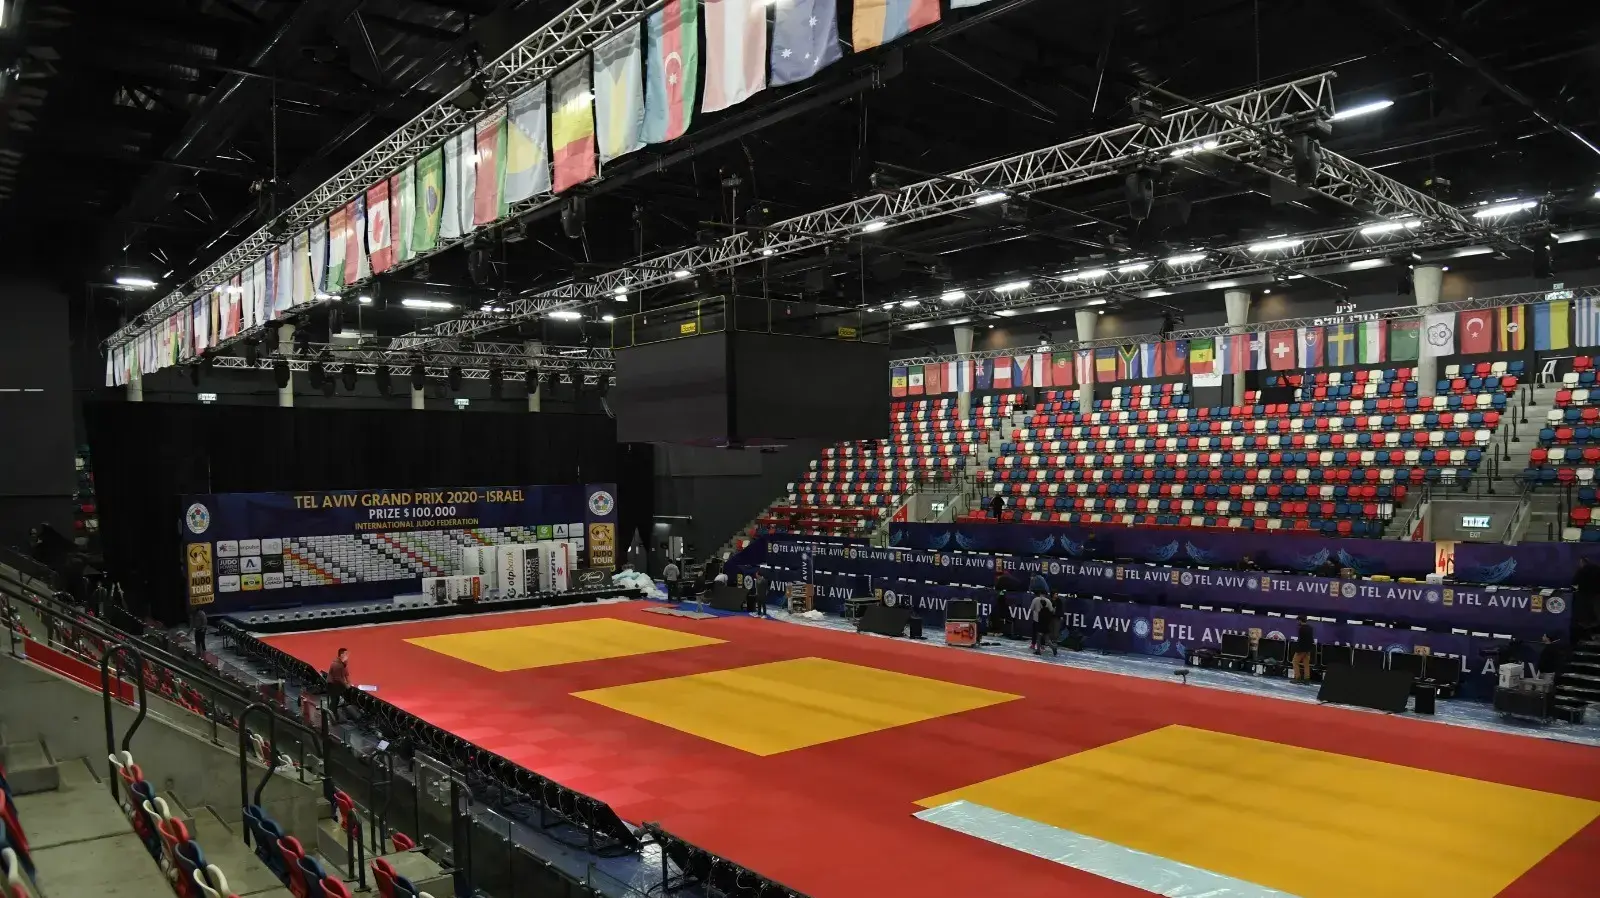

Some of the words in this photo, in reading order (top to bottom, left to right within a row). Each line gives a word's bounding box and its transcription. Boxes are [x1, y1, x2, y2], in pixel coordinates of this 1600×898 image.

[294, 495, 318, 508] TEL
[322, 494, 358, 508] AVIV
[362, 493, 411, 506] GRAND
[415, 492, 444, 505] PRIX
[369, 508, 400, 520] PRIZE
[403, 508, 409, 518] $
[412, 506, 456, 519] 100,000
[355, 520, 414, 530] INTERNATIONAL
[416, 519, 435, 528] JUDO
[437, 518, 478, 527] FEDERATION
[829, 548, 844, 556] AVIV
[858, 550, 868, 559] TEL
[871, 552, 887, 560] AVIV
[902, 554, 913, 562] TEL
[916, 554, 934, 564] AVIV
[950, 557, 963, 566] TEL
[966, 558, 985, 568] AVIV
[506, 552, 516, 586] otpbank
[1003, 561, 1016, 570] TEL
[1019, 561, 1041, 572] AVIV
[1061, 565, 1075, 574] TEL
[1079, 566, 1103, 576] AVIV
[192, 577, 210, 586] JUDO
[1125, 570, 1140, 580] TEL
[1144, 571, 1170, 582] AVIV
[1194, 574, 1212, 586] TEL
[1216, 576, 1245, 588] AVIV
[191, 585, 211, 594] TOUR
[829, 587, 853, 599] AVIV
[1272, 580, 1292, 591] TEL
[1296, 581, 1328, 594] AVIV
[1360, 586, 1382, 598] TEL
[1387, 587, 1423, 601] AVIV
[919, 597, 946, 610] AVIV
[1457, 593, 1482, 606] TEL
[1488, 595, 1529, 609] AVIV
[1009, 606, 1032, 620] VIV
[1064, 612, 1086, 628] TEL
[1093, 616, 1130, 633] AVIV
[1168, 624, 1195, 640] TEL
